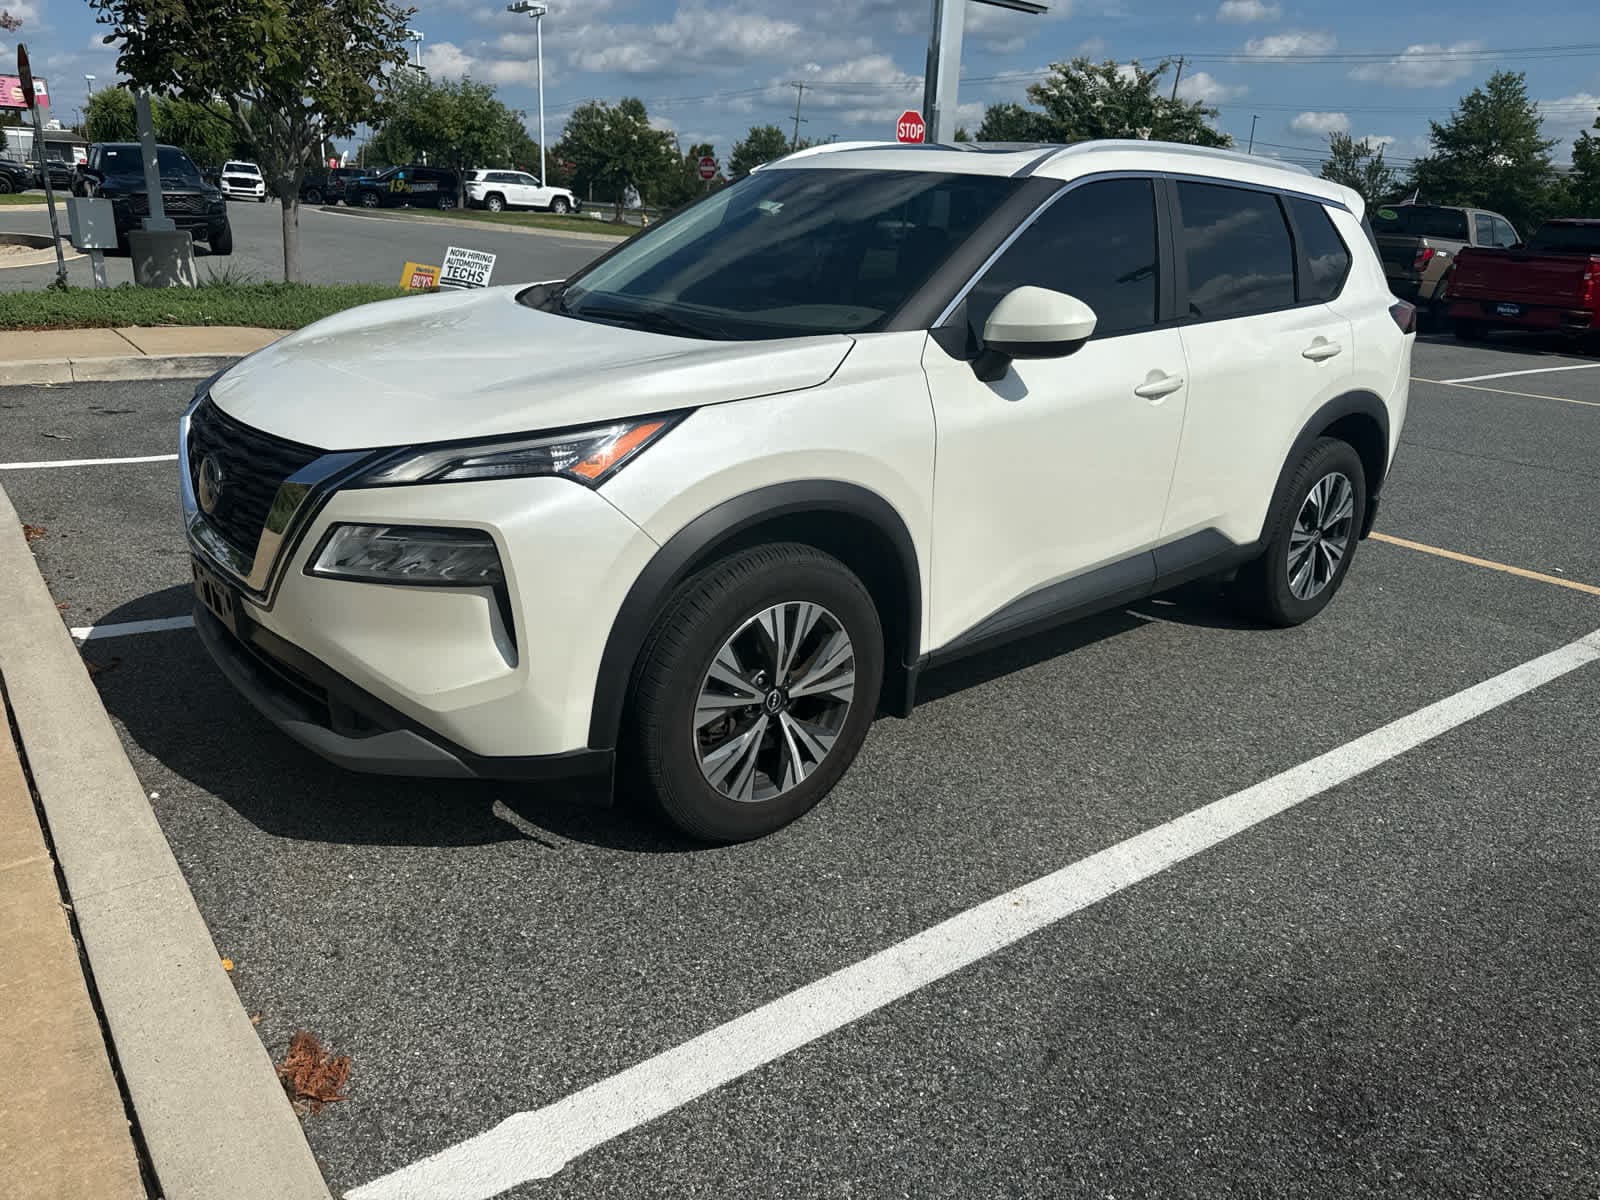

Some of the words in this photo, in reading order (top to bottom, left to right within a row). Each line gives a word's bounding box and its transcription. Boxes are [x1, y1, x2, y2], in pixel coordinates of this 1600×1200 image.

[899, 122, 923, 139] STOP
[449, 248, 467, 259] NOW
[468, 251, 493, 263] HIRING
[445, 257, 491, 273] AUTOMOTIVE
[411, 274, 433, 288] BUYS
[447, 265, 485, 283] TECHS
